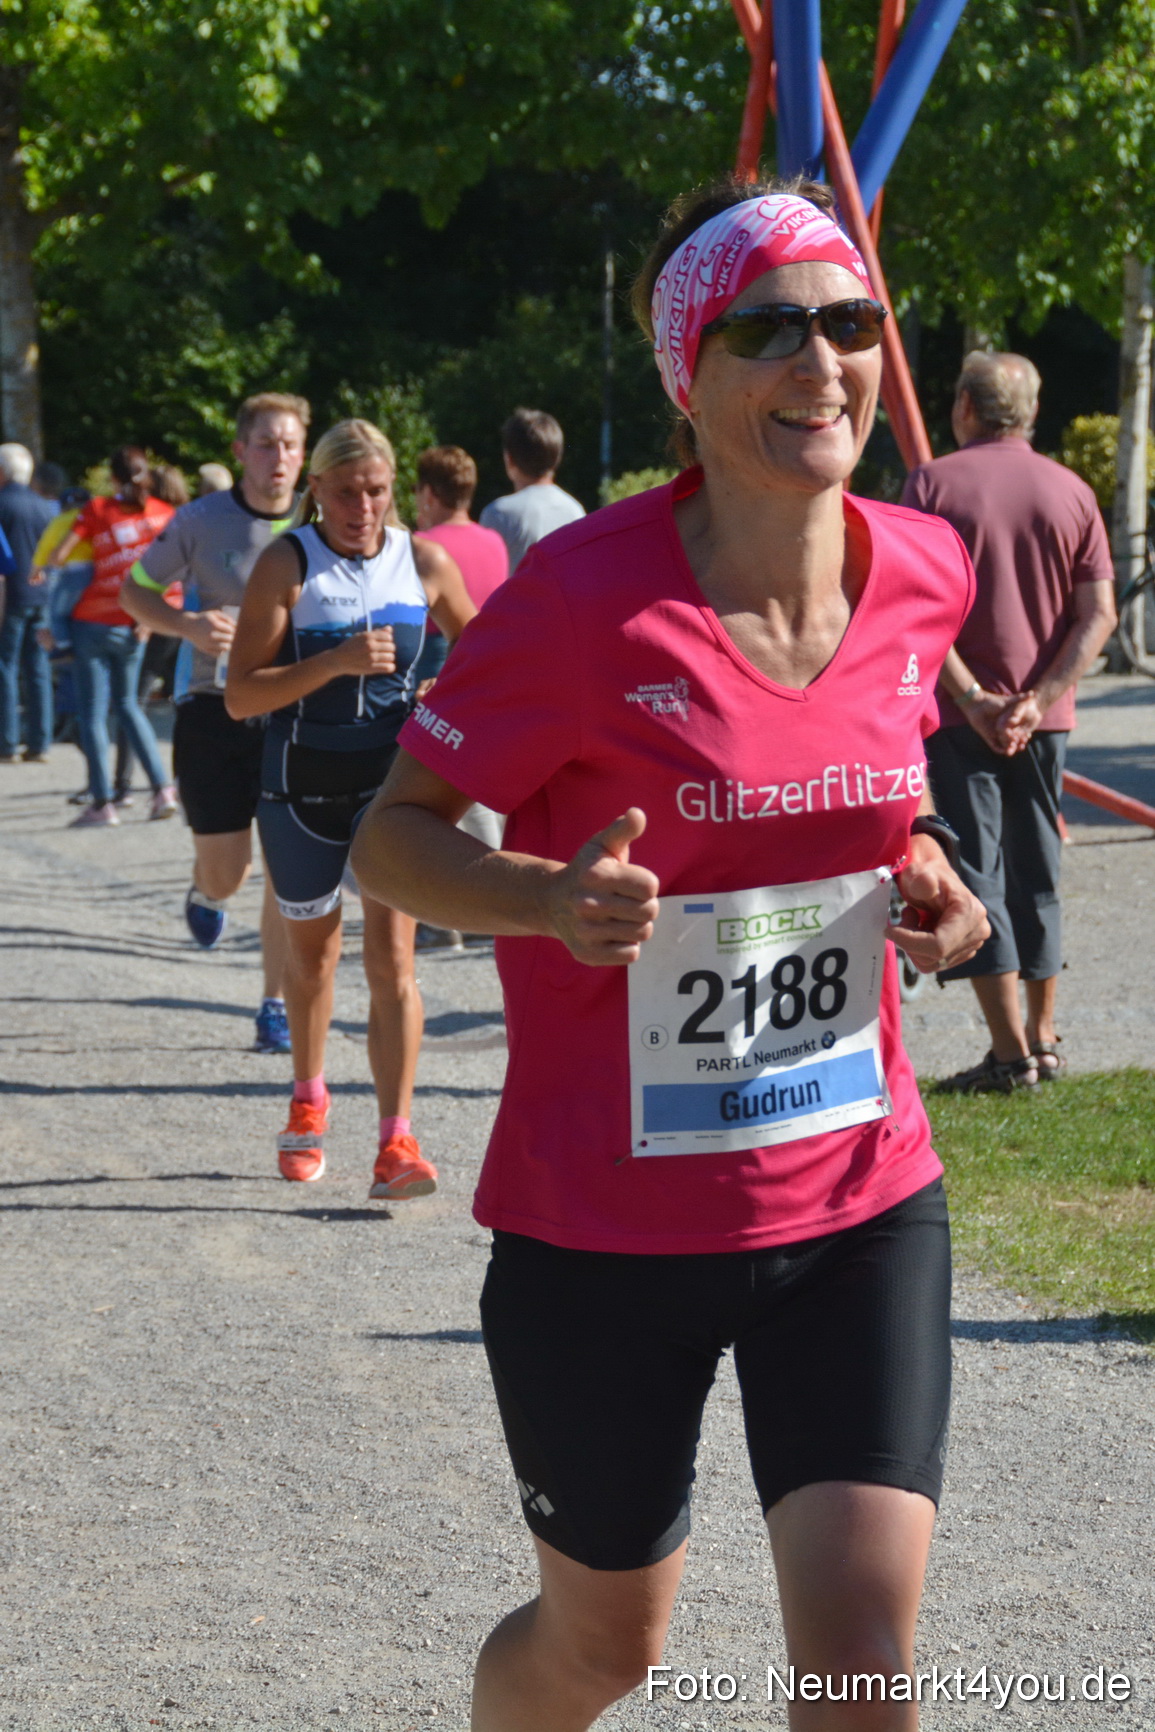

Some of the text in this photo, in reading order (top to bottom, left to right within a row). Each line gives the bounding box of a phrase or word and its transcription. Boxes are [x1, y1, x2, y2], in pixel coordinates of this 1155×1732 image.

[715, 229, 750, 298] VIKING
[668, 244, 698, 376] VIKING
[624, 691, 676, 703] Women's
[637, 683, 674, 693] BARMER
[652, 700, 682, 715] Run
[717, 904, 823, 945] BOCK
[717, 942, 752, 955] inspired
[763, 934, 785, 948] smart
[786, 930, 824, 944] concepts
[677, 947, 849, 1044] 2188
[650, 1031, 660, 1045] B
[696, 1038, 817, 1072] PARTL Neumarkt
[719, 1079, 822, 1122] Gudrun
